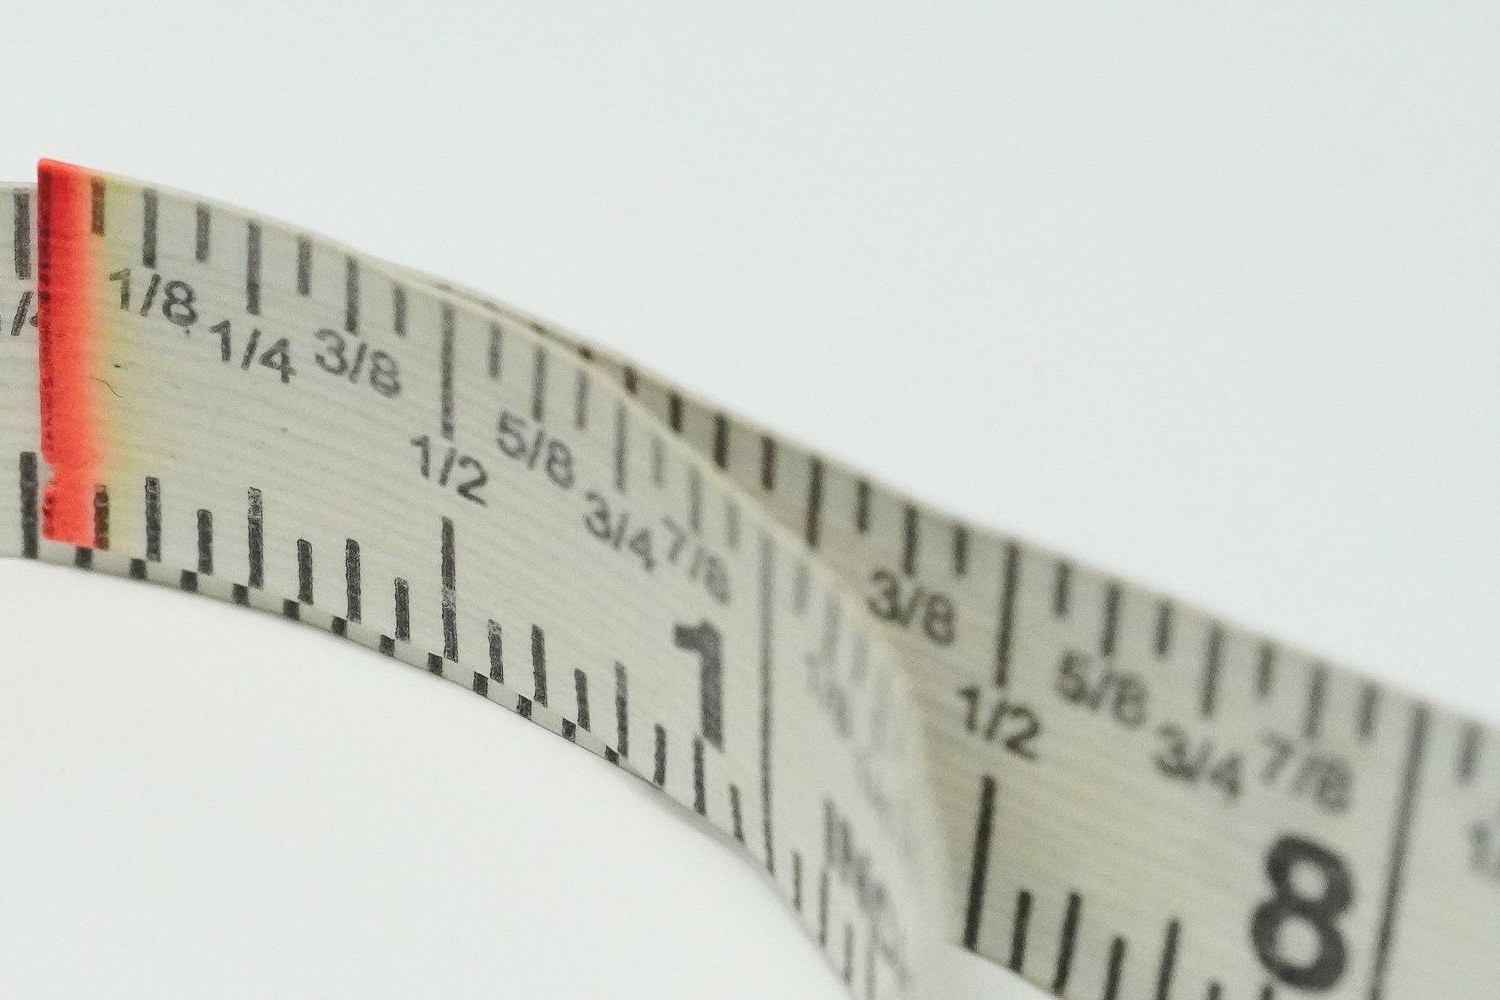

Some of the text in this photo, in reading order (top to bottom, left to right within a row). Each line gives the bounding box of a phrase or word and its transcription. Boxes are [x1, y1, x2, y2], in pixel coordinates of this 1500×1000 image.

[109, 266, 198, 328] 1/8
[209, 318, 299, 384] 1/4
[314, 328, 404, 399] 3/8
[409, 433, 490, 507] 1/2
[495, 408, 576, 491] 5/8
[582, 491, 657, 574] 3/4
[866, 568, 958, 650] 3/8
[672, 620, 725, 754] 1
[955, 683, 1042, 762] 1/2
[1055, 650, 1149, 730] 5/8
[1151, 720, 1245, 803] 3/4
[1257, 731, 1355, 815] 7/8
[1248, 834, 1358, 994] 8
